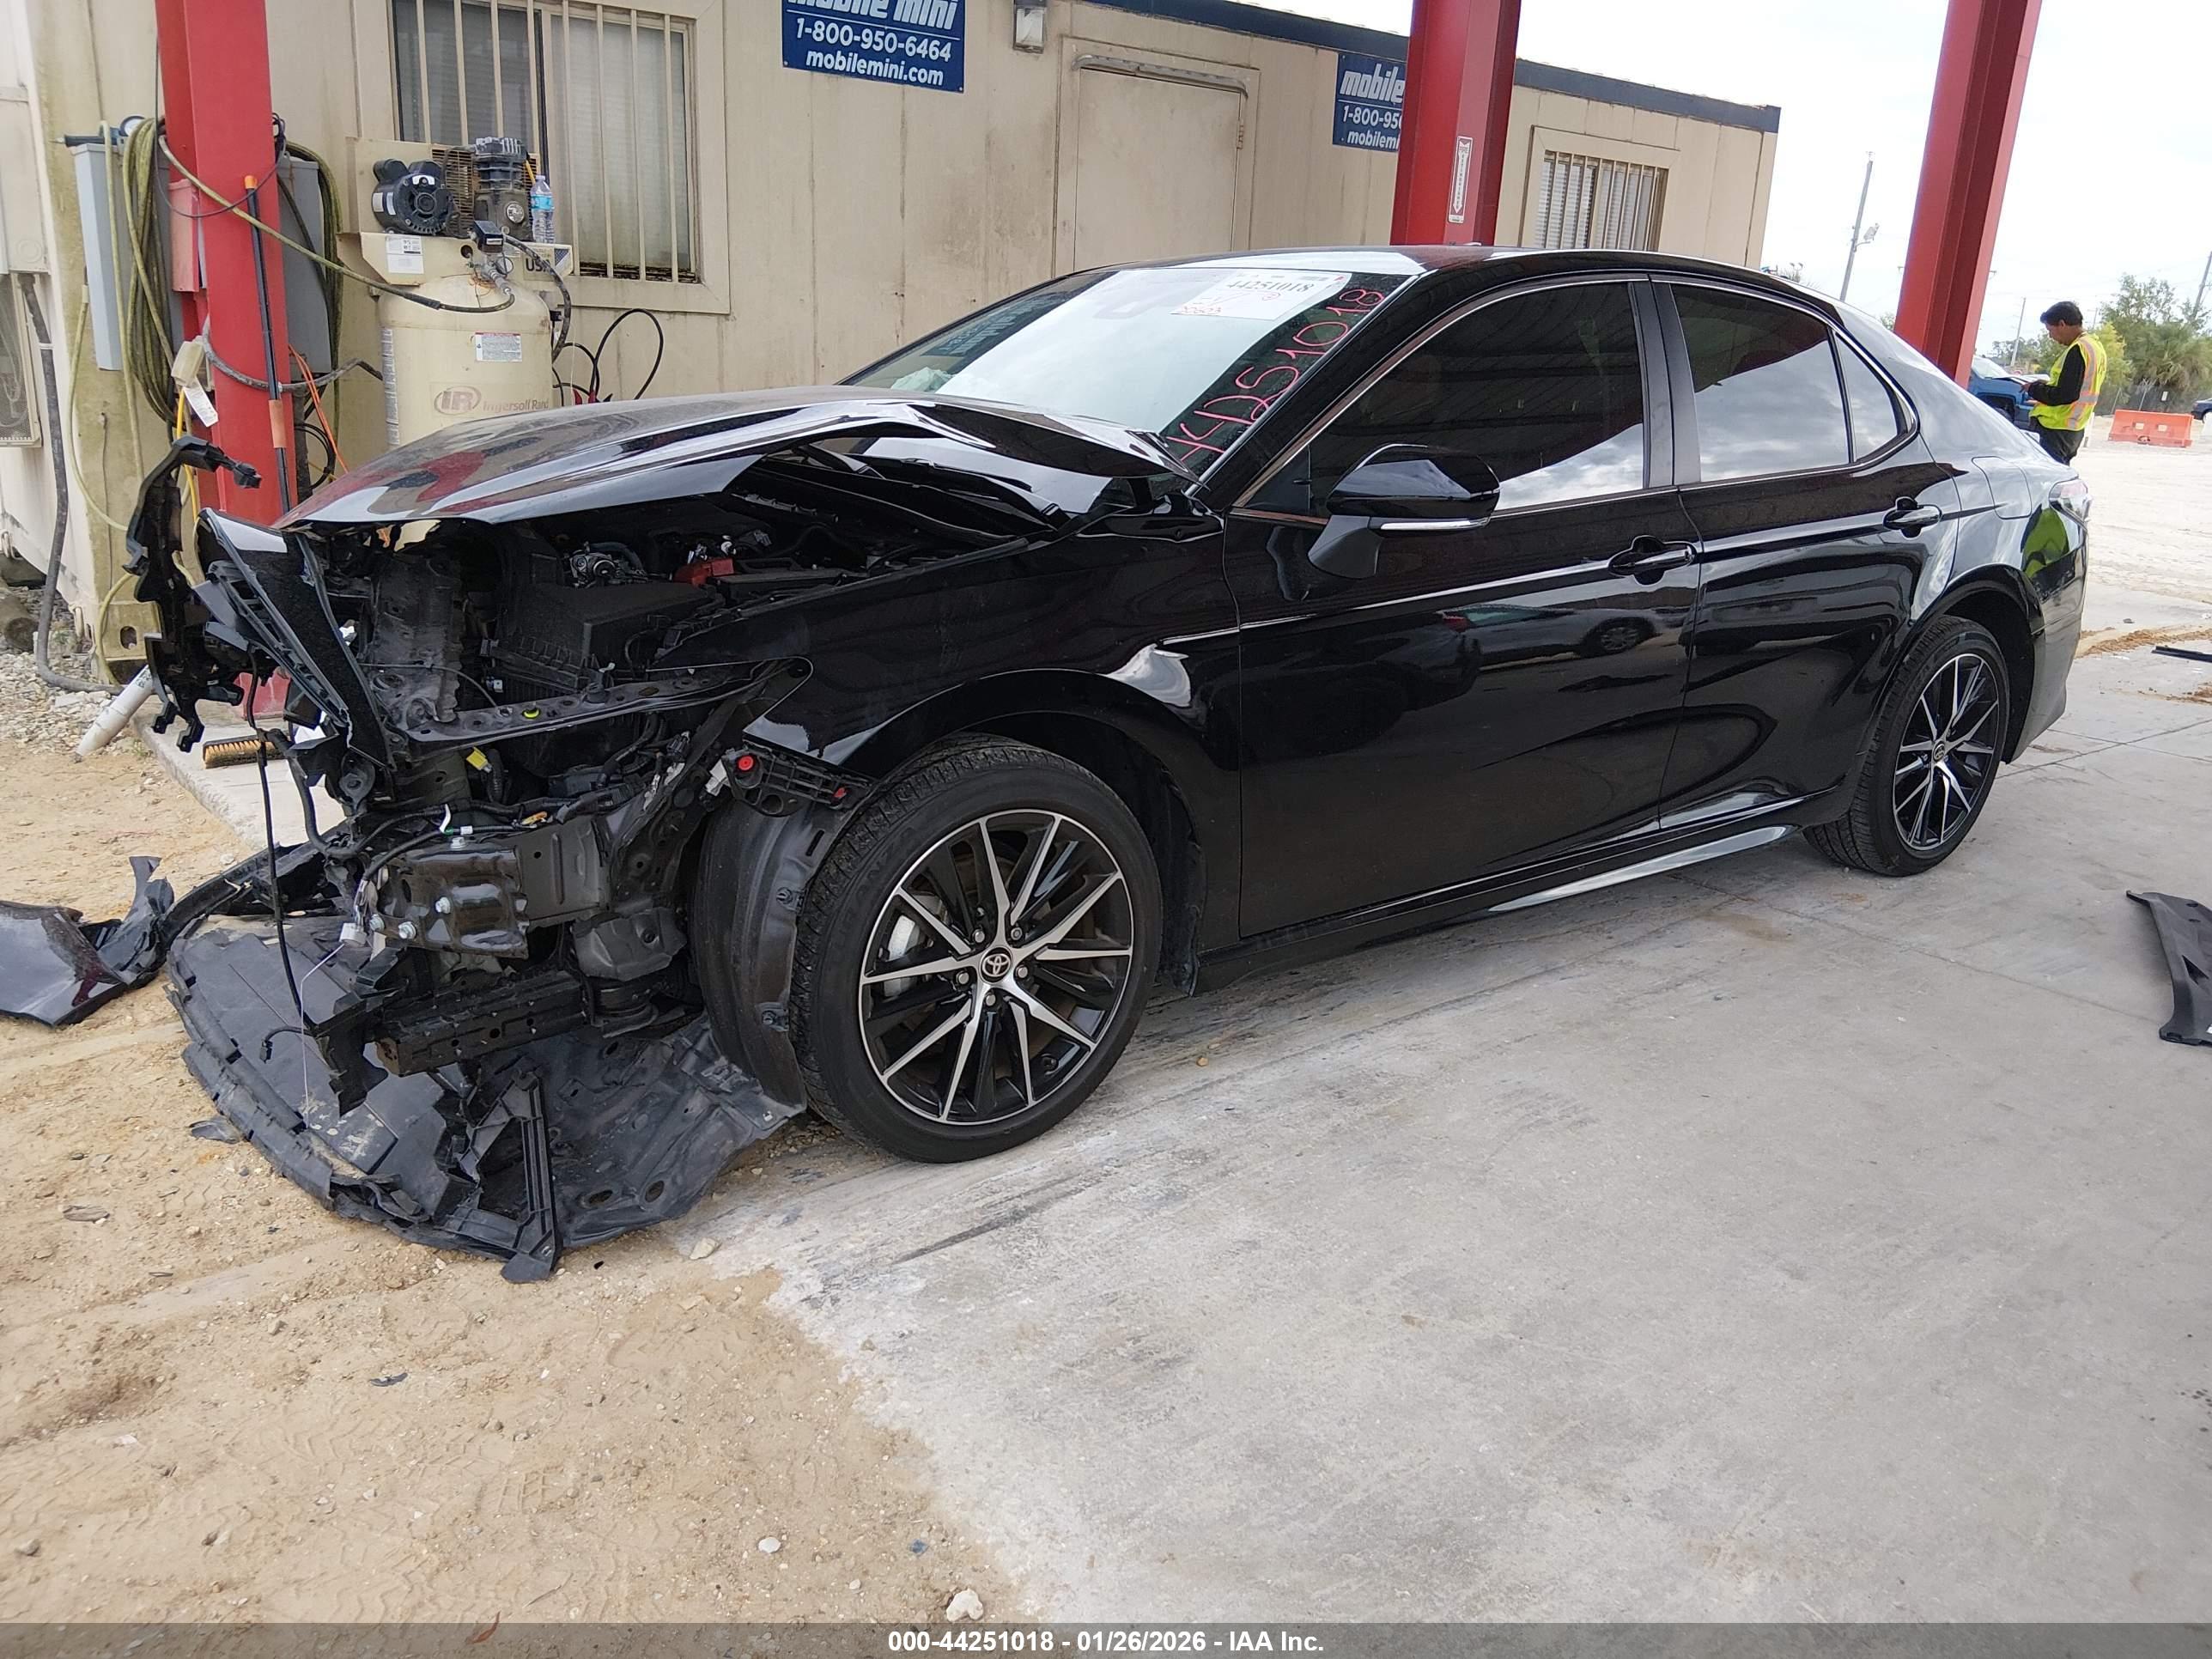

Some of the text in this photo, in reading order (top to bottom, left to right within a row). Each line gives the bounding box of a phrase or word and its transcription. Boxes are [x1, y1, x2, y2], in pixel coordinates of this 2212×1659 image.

[796, 18, 951, 63] 1-800-950-6464
[805, 50, 944, 86] mobilemini.com
[1340, 64, 1406, 103] mobile
